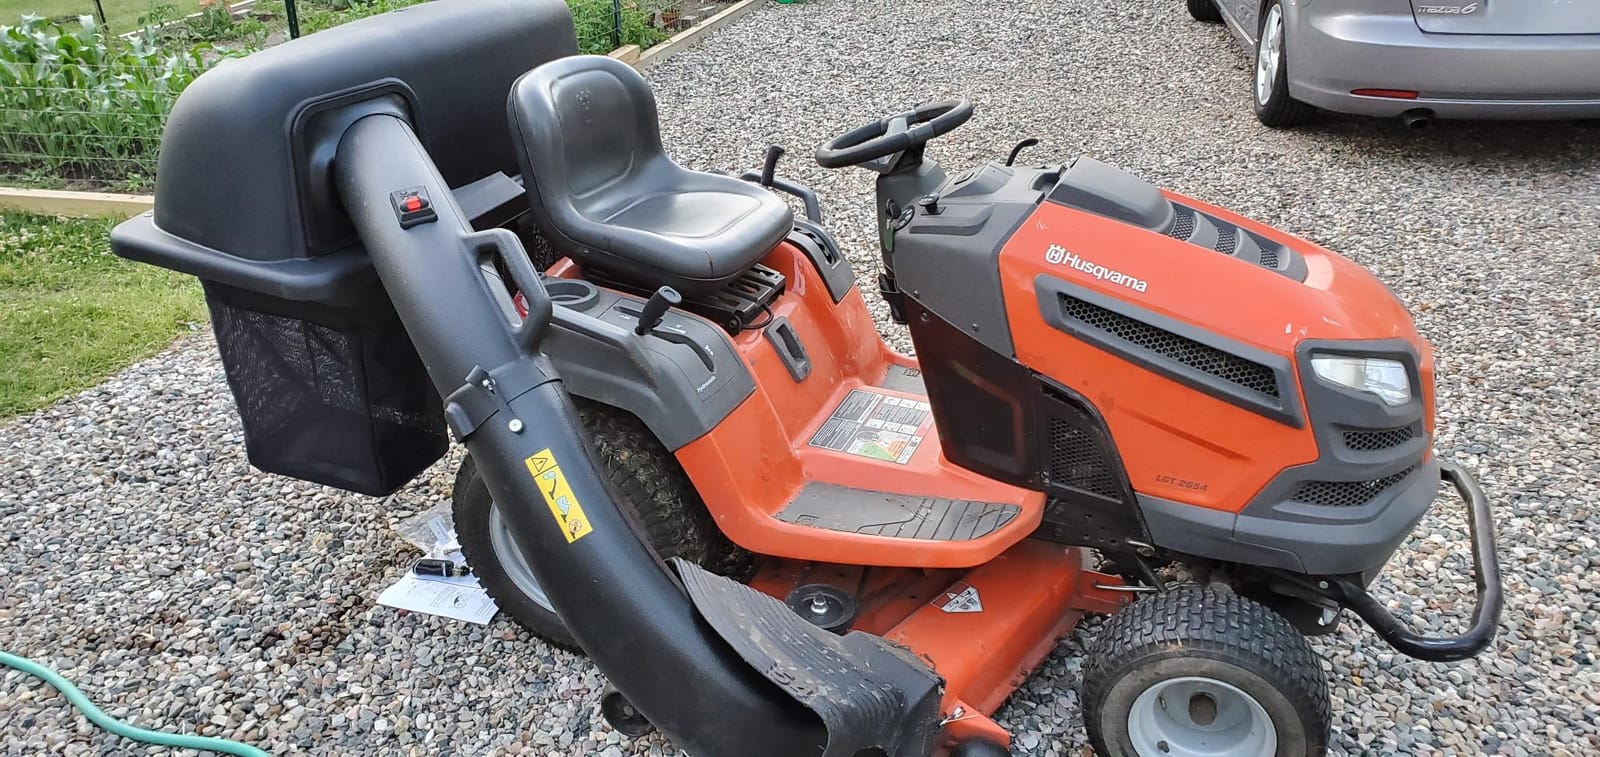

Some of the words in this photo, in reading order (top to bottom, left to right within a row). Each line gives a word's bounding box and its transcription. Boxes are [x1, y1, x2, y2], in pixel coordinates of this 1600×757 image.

[1062, 251, 1148, 292] Husqvarna
[1155, 474, 1177, 485] LGT
[1178, 479, 1209, 492] 2654
